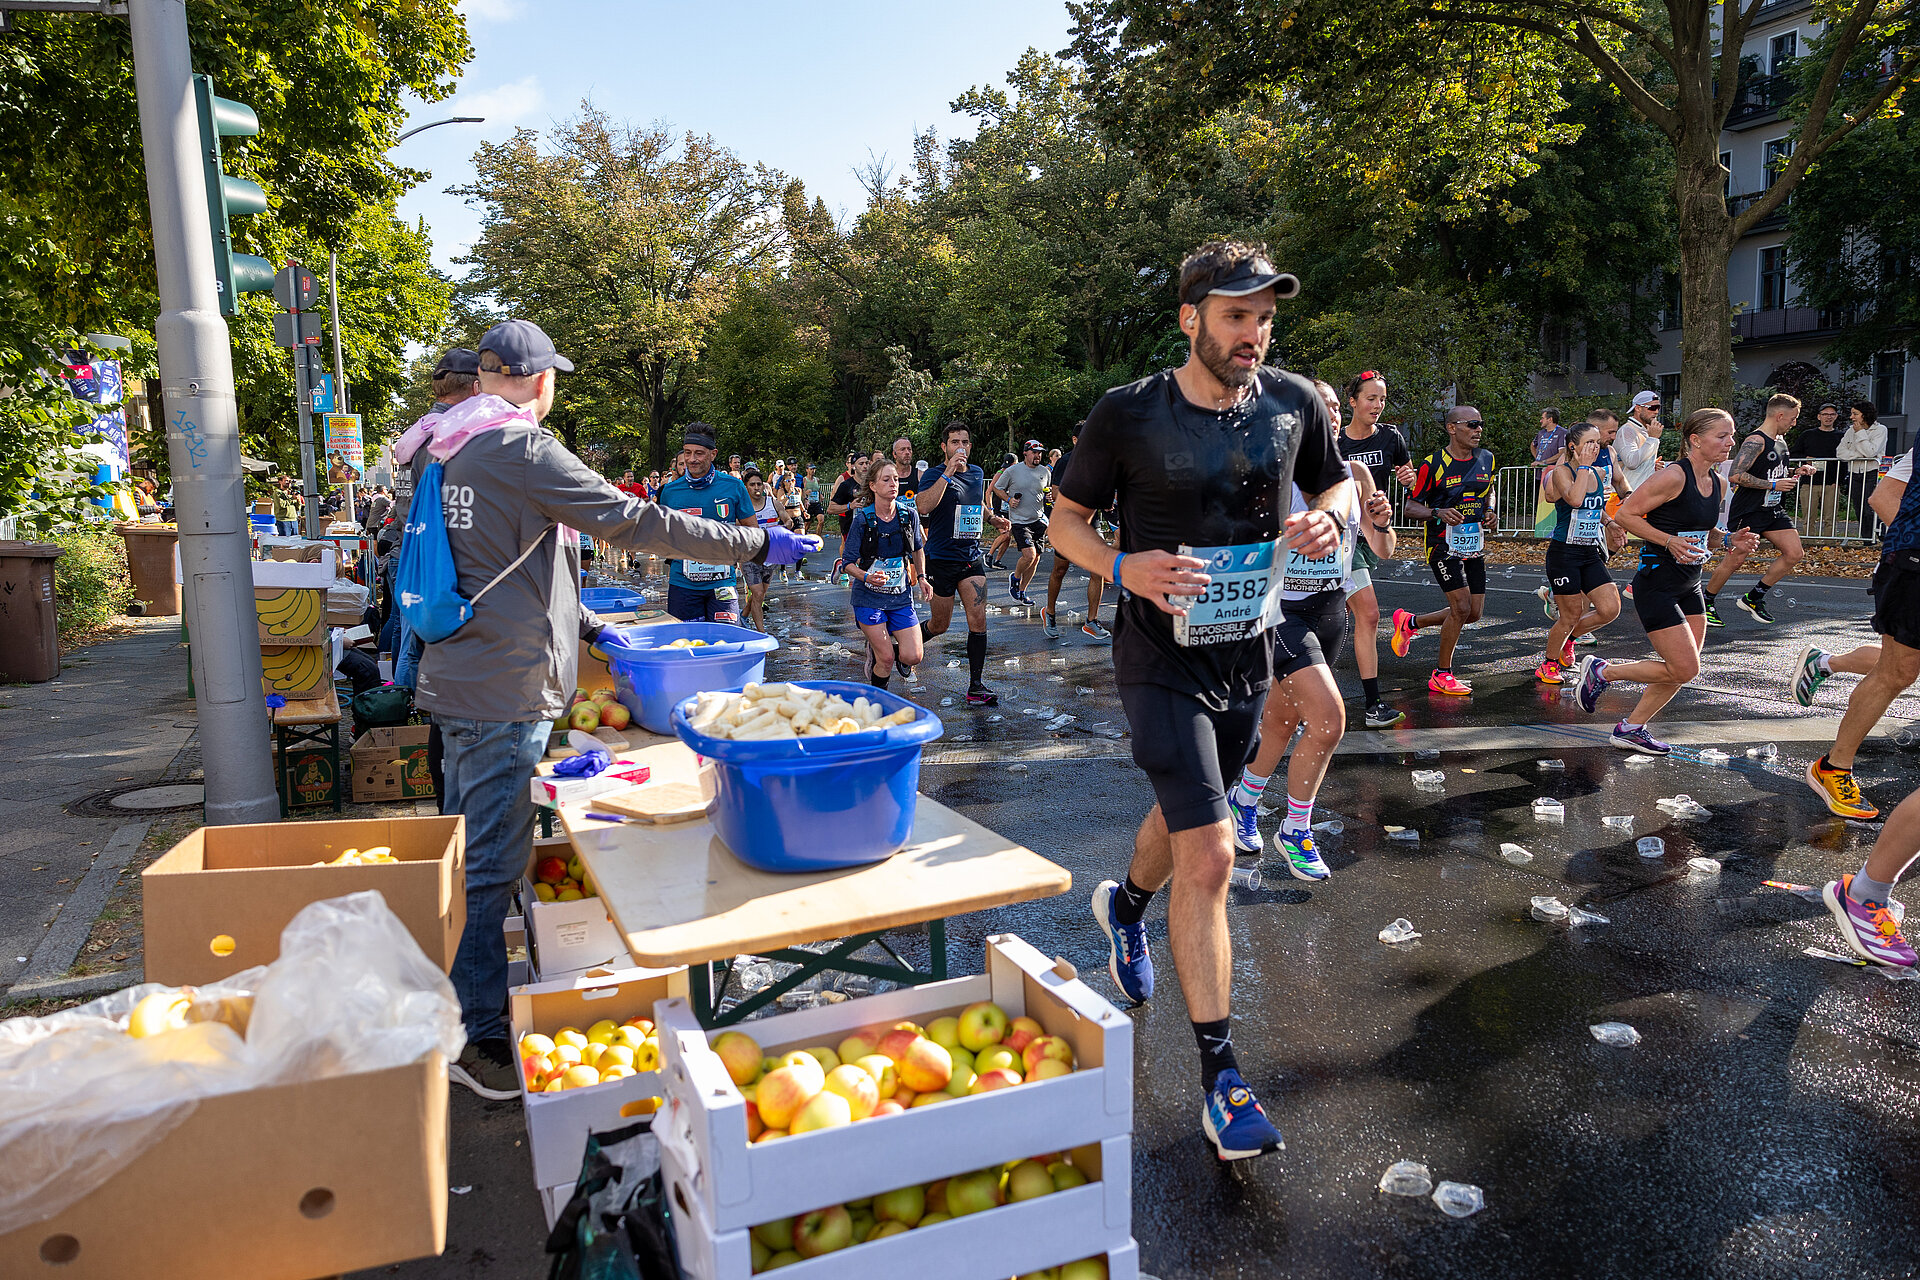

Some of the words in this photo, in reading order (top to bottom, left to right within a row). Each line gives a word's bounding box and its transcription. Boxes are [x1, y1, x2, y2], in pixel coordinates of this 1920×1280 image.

[448, 485, 475, 507] 20
[448, 508, 474, 530] 23
[1462, 508, 1476, 516] COL
[1286, 567, 1307, 575] Maria
[1214, 605, 1251, 619] André
[1190, 622, 1246, 636] IMPOSSIBLE
[1190, 636, 1199, 646] IS
[1200, 632, 1243, 645] NOTHING
[305, 790, 326, 802] BIO
[415, 784, 434, 795] BIO
